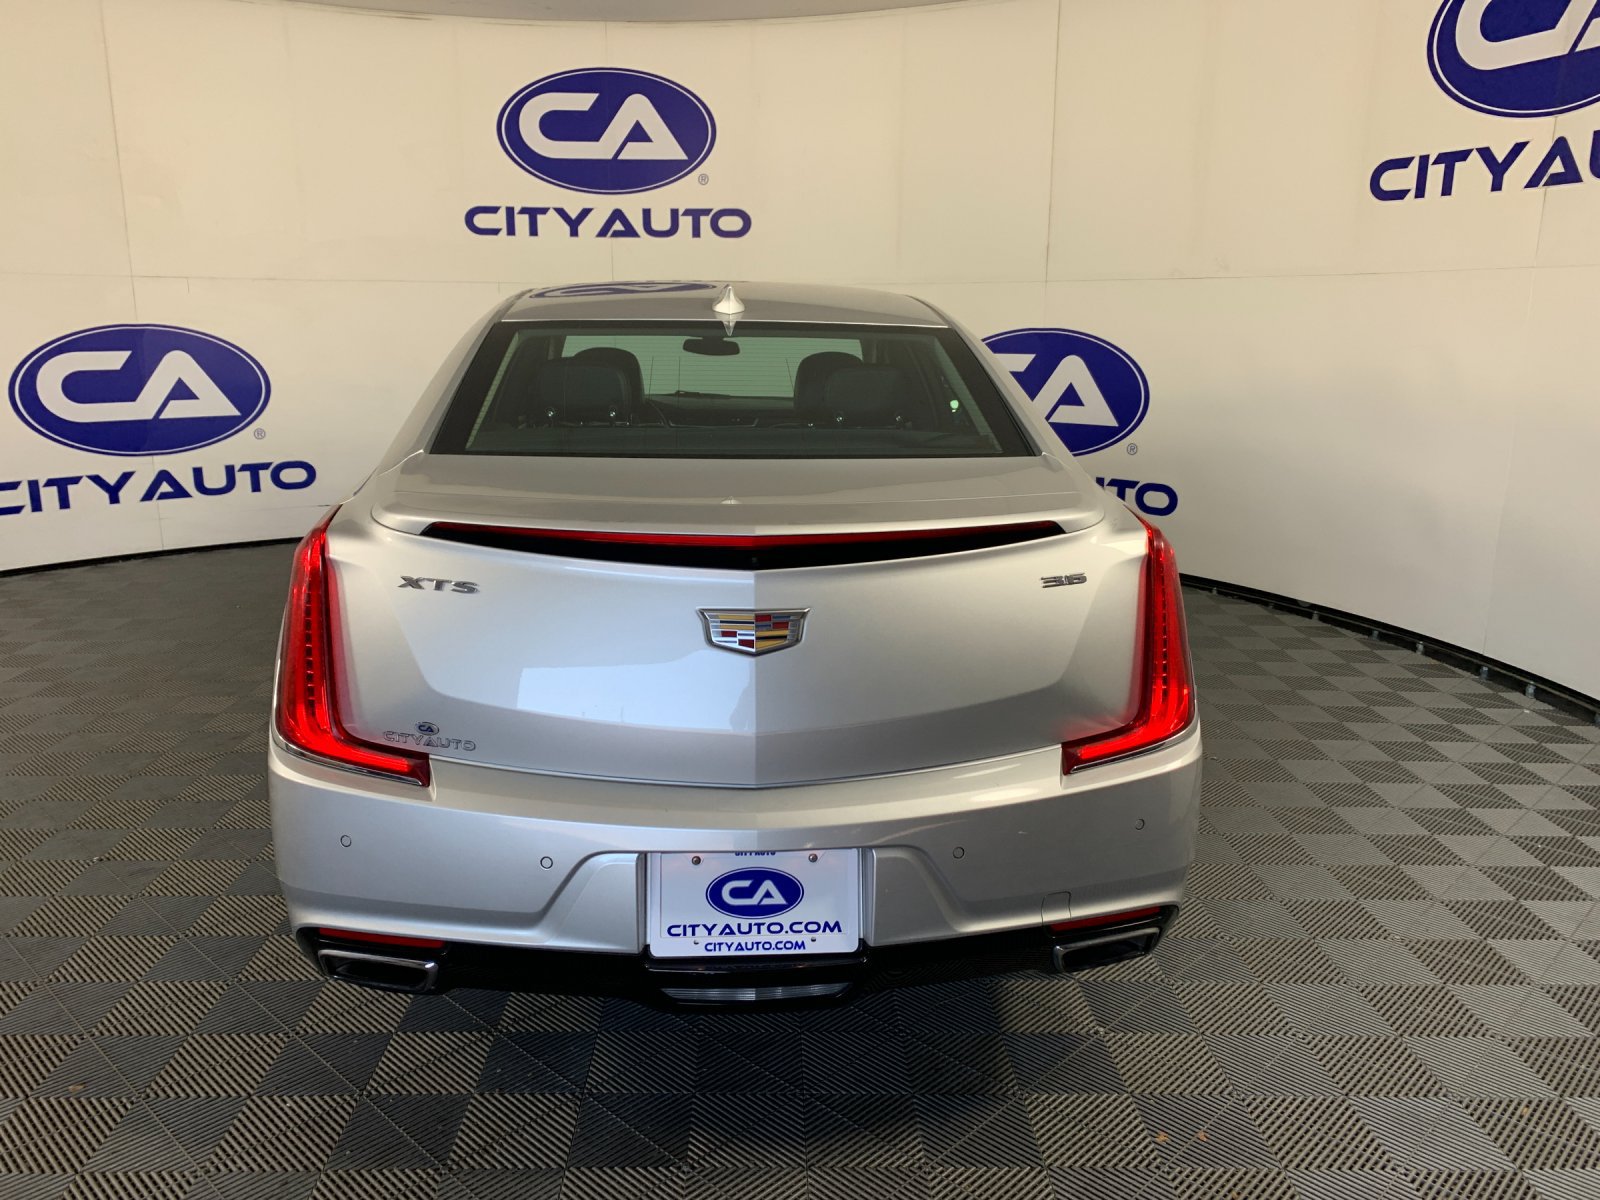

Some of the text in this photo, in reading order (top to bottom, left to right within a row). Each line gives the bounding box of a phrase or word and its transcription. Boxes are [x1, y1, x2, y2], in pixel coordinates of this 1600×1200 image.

[518, 91, 689, 160] CA
[36, 349, 242, 423] CA
[993, 353, 1119, 427] A
[397, 575, 480, 594] XTS
[721, 879, 789, 906] CA
[667, 920, 843, 937] CITYAUTO.COM
[704, 940, 806, 952] CITYAUTO.COM
